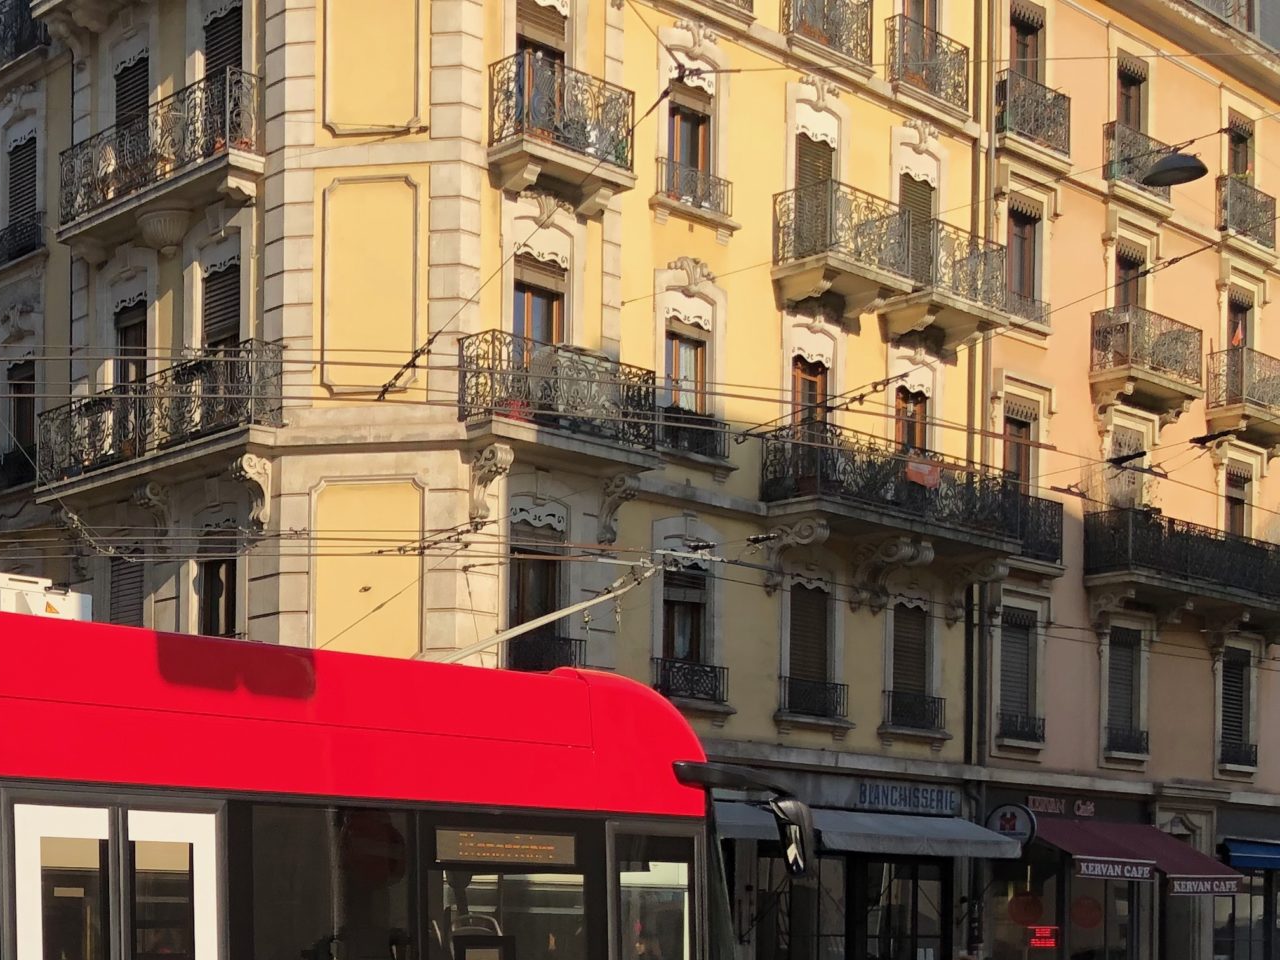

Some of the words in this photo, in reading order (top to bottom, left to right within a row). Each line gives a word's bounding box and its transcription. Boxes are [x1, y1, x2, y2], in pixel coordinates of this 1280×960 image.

[859, 782, 956, 811] BLANCHISSERIE
[1080, 862, 1121, 877] KERVAN
[1123, 865, 1151, 878] CAFE
[1173, 880, 1211, 892] KERVAN
[1213, 880, 1238, 892] CAFE
